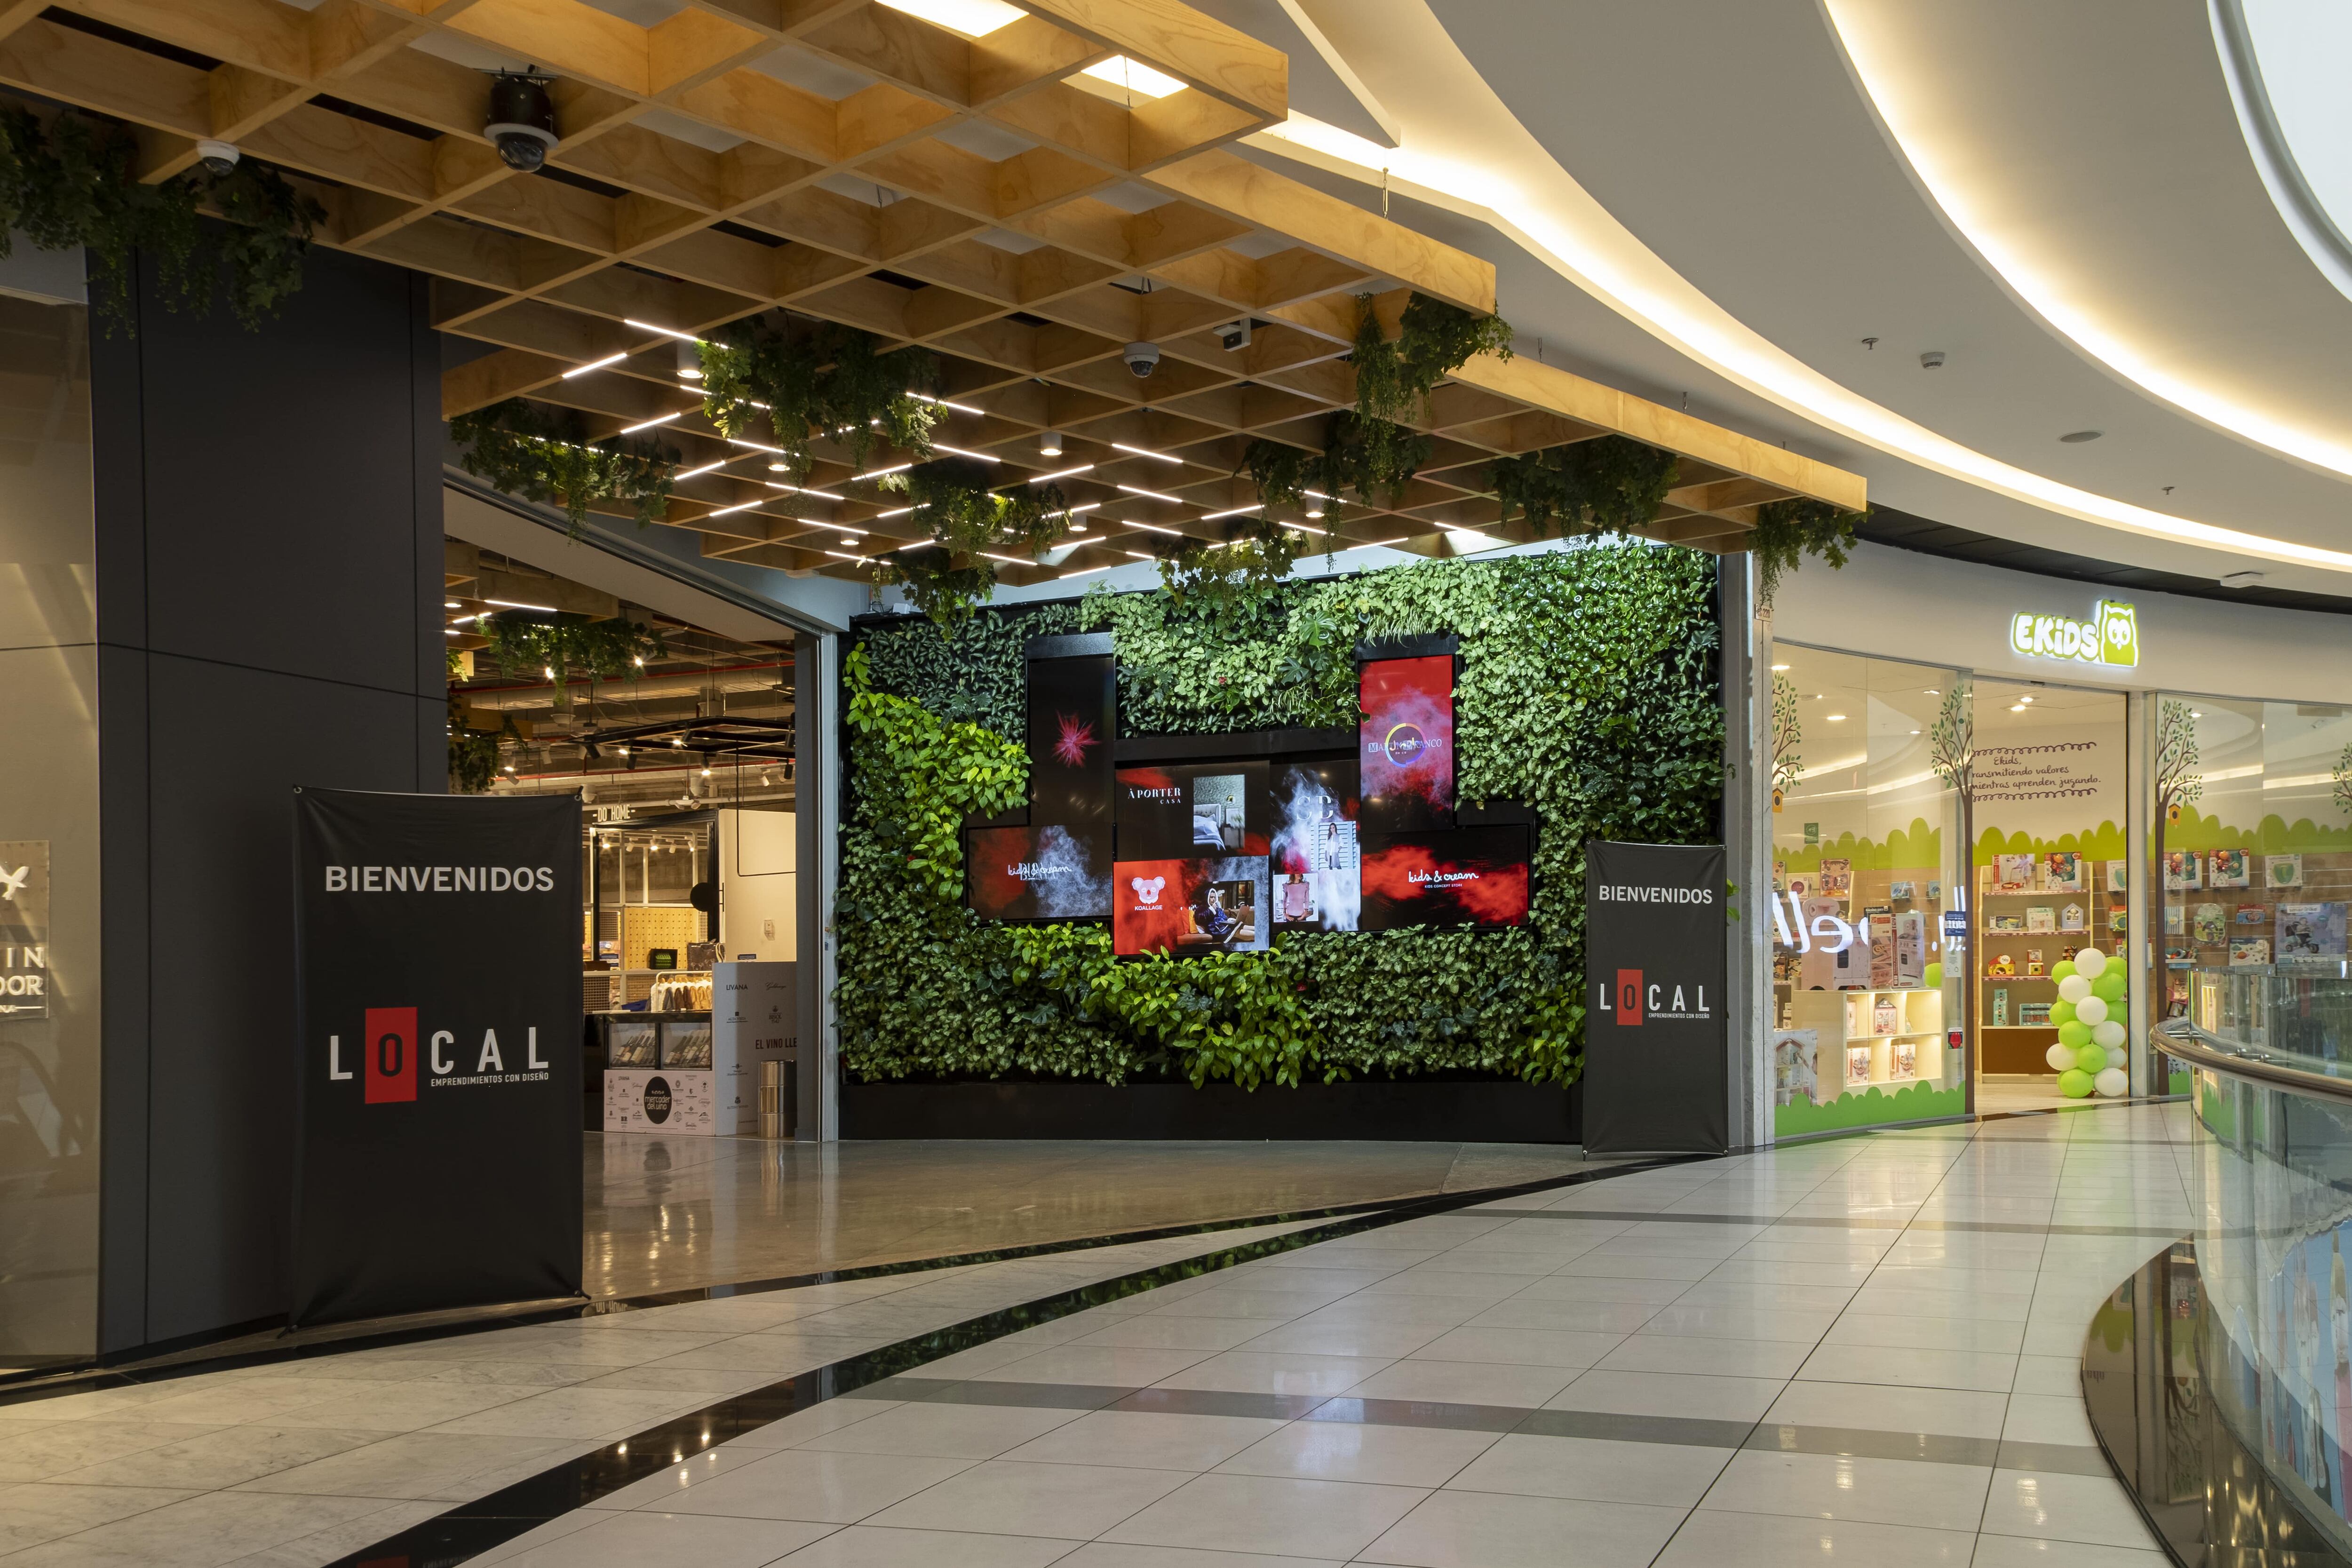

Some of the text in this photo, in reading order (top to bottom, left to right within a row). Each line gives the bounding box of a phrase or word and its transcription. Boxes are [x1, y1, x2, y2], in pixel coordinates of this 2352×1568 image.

[1972, 765, 2069, 778] ransmitiendo valores
[2013, 777, 2056, 790] aprenden
[2059, 774, 2101, 788] jugando.
[1137, 788, 1181, 798] PORTER
[325, 866, 554, 892] BIENVENIDOS
[1408, 869, 1432, 883] kids
[1434, 870, 1442, 882] &
[1599, 885, 1713, 904] BIENVENIDOS
[1600, 983, 1710, 1011] LOCAL
[755, 1039, 764, 1050] EL
[766, 1038, 783, 1049] VINO
[330, 1027, 549, 1080] LOCAL
[430, 1071, 549, 1087] EMPRENDIMIENTOS CON DISEÑO
